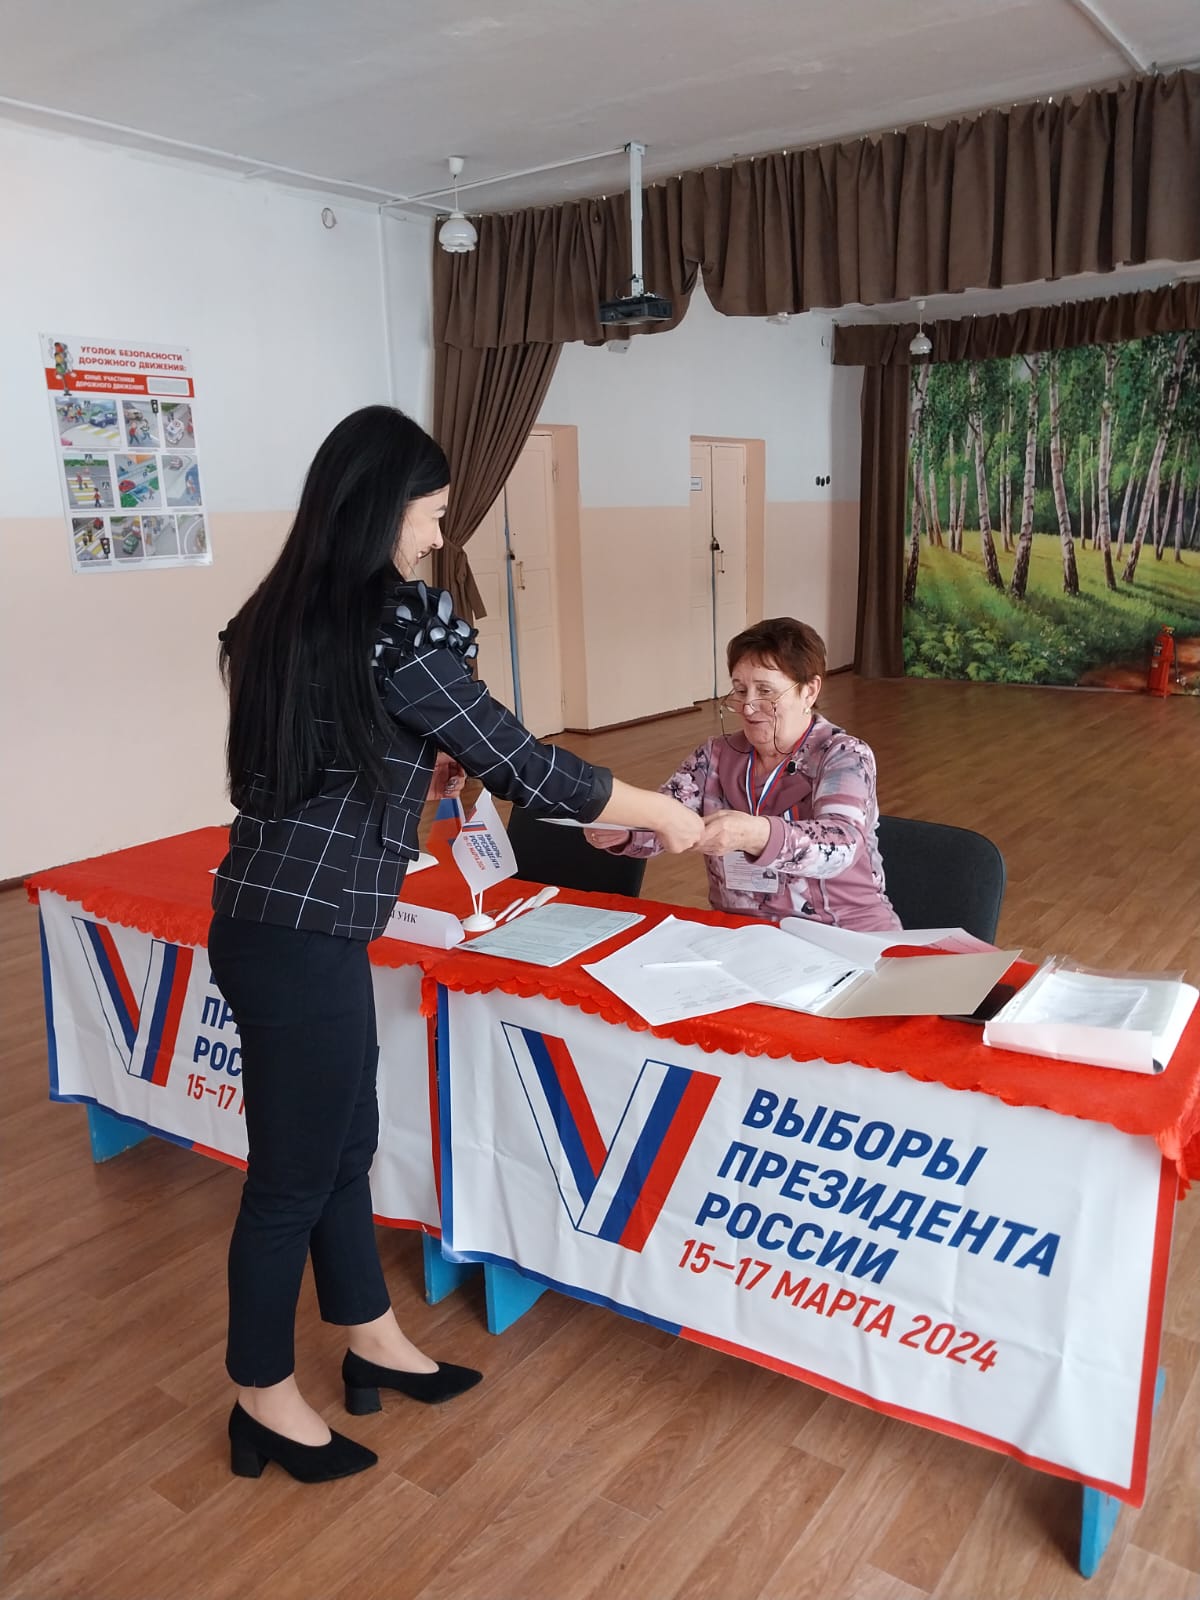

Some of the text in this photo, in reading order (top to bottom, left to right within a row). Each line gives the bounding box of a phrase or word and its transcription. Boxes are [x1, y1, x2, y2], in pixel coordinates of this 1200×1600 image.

[78, 356, 137, 368] ДОРОЖНОГО
[80, 345, 183, 361] УГОЛОК БЕЗОПАСНОСТИ
[469, 835, 486, 857] РОССИИ
[476, 834, 501, 869] ПРЕЗИДЕНТА
[484, 833, 502, 858] ВЫБОРЫ
[397, 910, 418, 924] УИК
[742, 1088, 988, 1186] ВЫБОРЫ
[717, 1141, 1061, 1277] ПРЕЗИДЕНТА
[695, 1192, 899, 1285] РОССИИ
[771, 1271, 895, 1338] МАРТА
[899, 1315, 999, 1373] 2024
